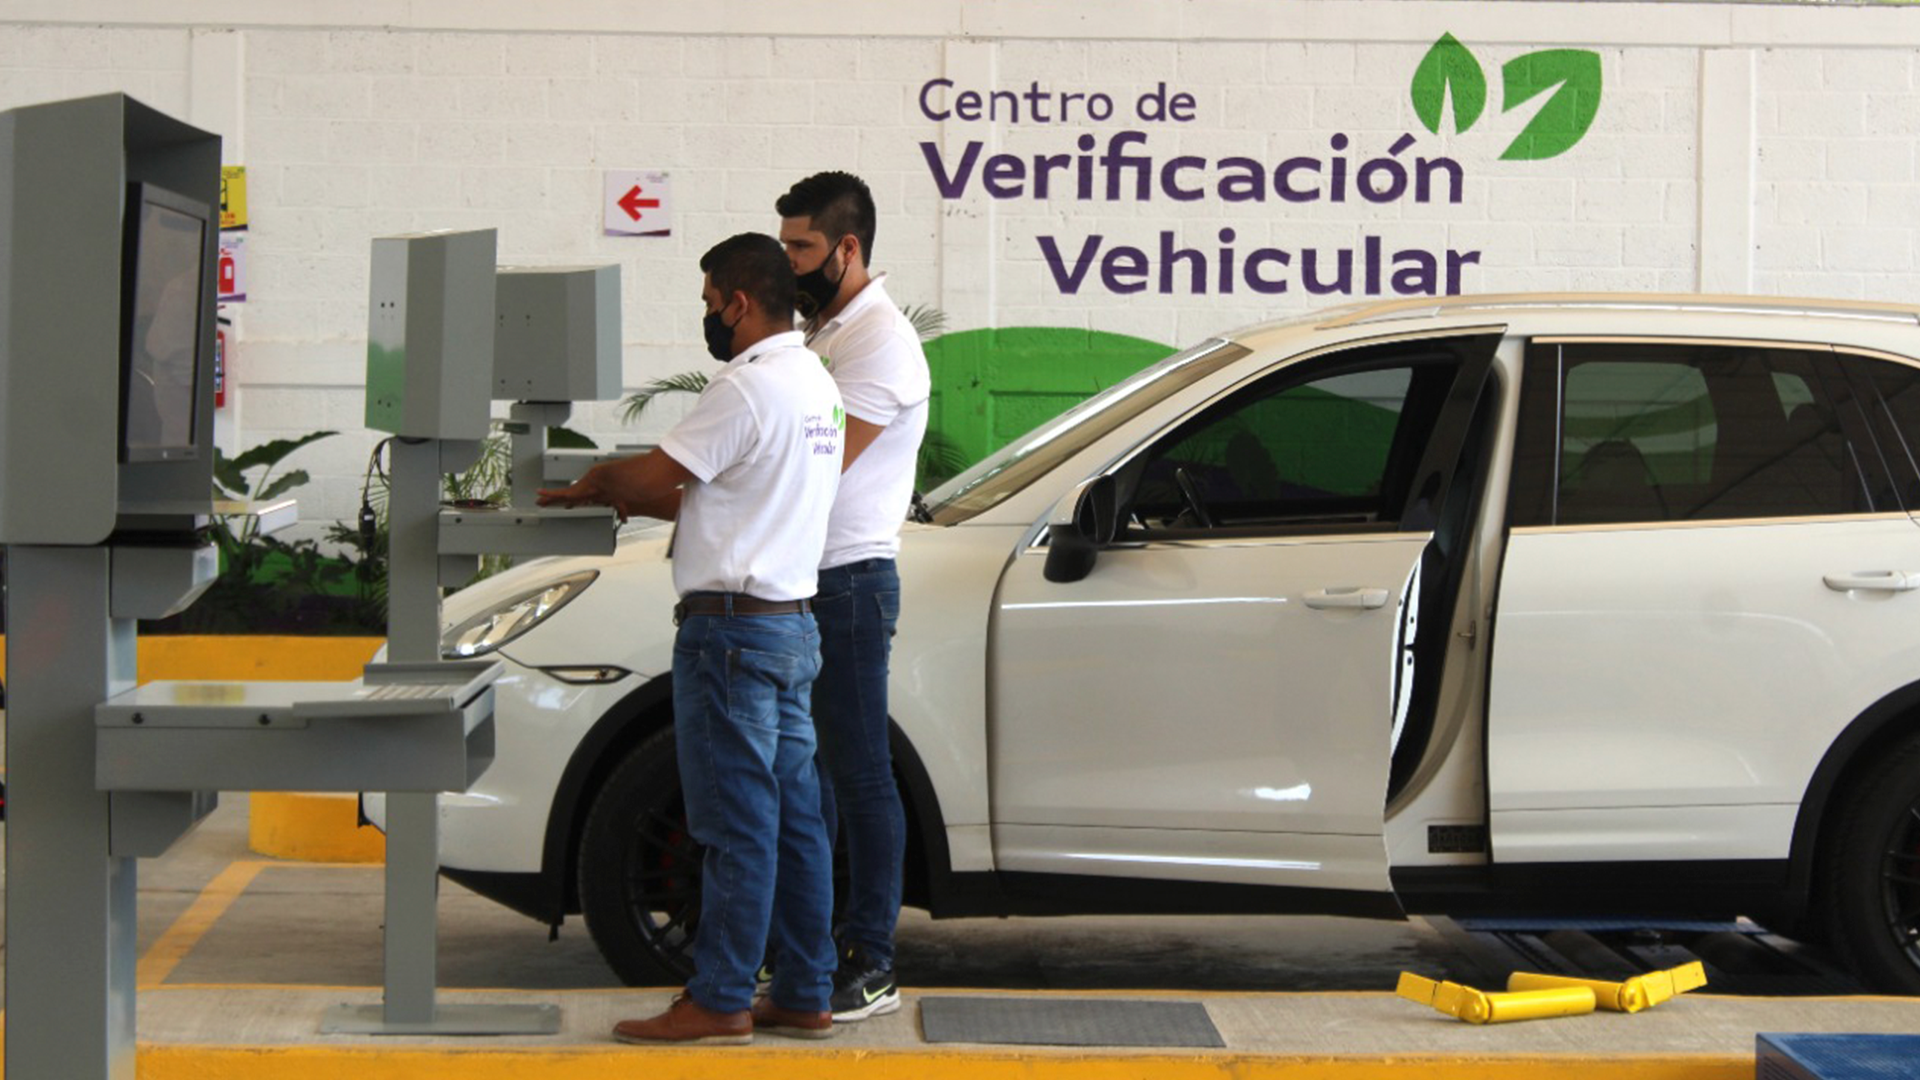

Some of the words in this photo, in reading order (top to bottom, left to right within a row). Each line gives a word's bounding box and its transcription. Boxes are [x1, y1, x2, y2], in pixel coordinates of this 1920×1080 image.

[919, 78, 1114, 123] Centro
[1136, 82, 1197, 122] de
[919, 131, 1464, 203] Verificación
[1036, 228, 1482, 296] Vehicular
